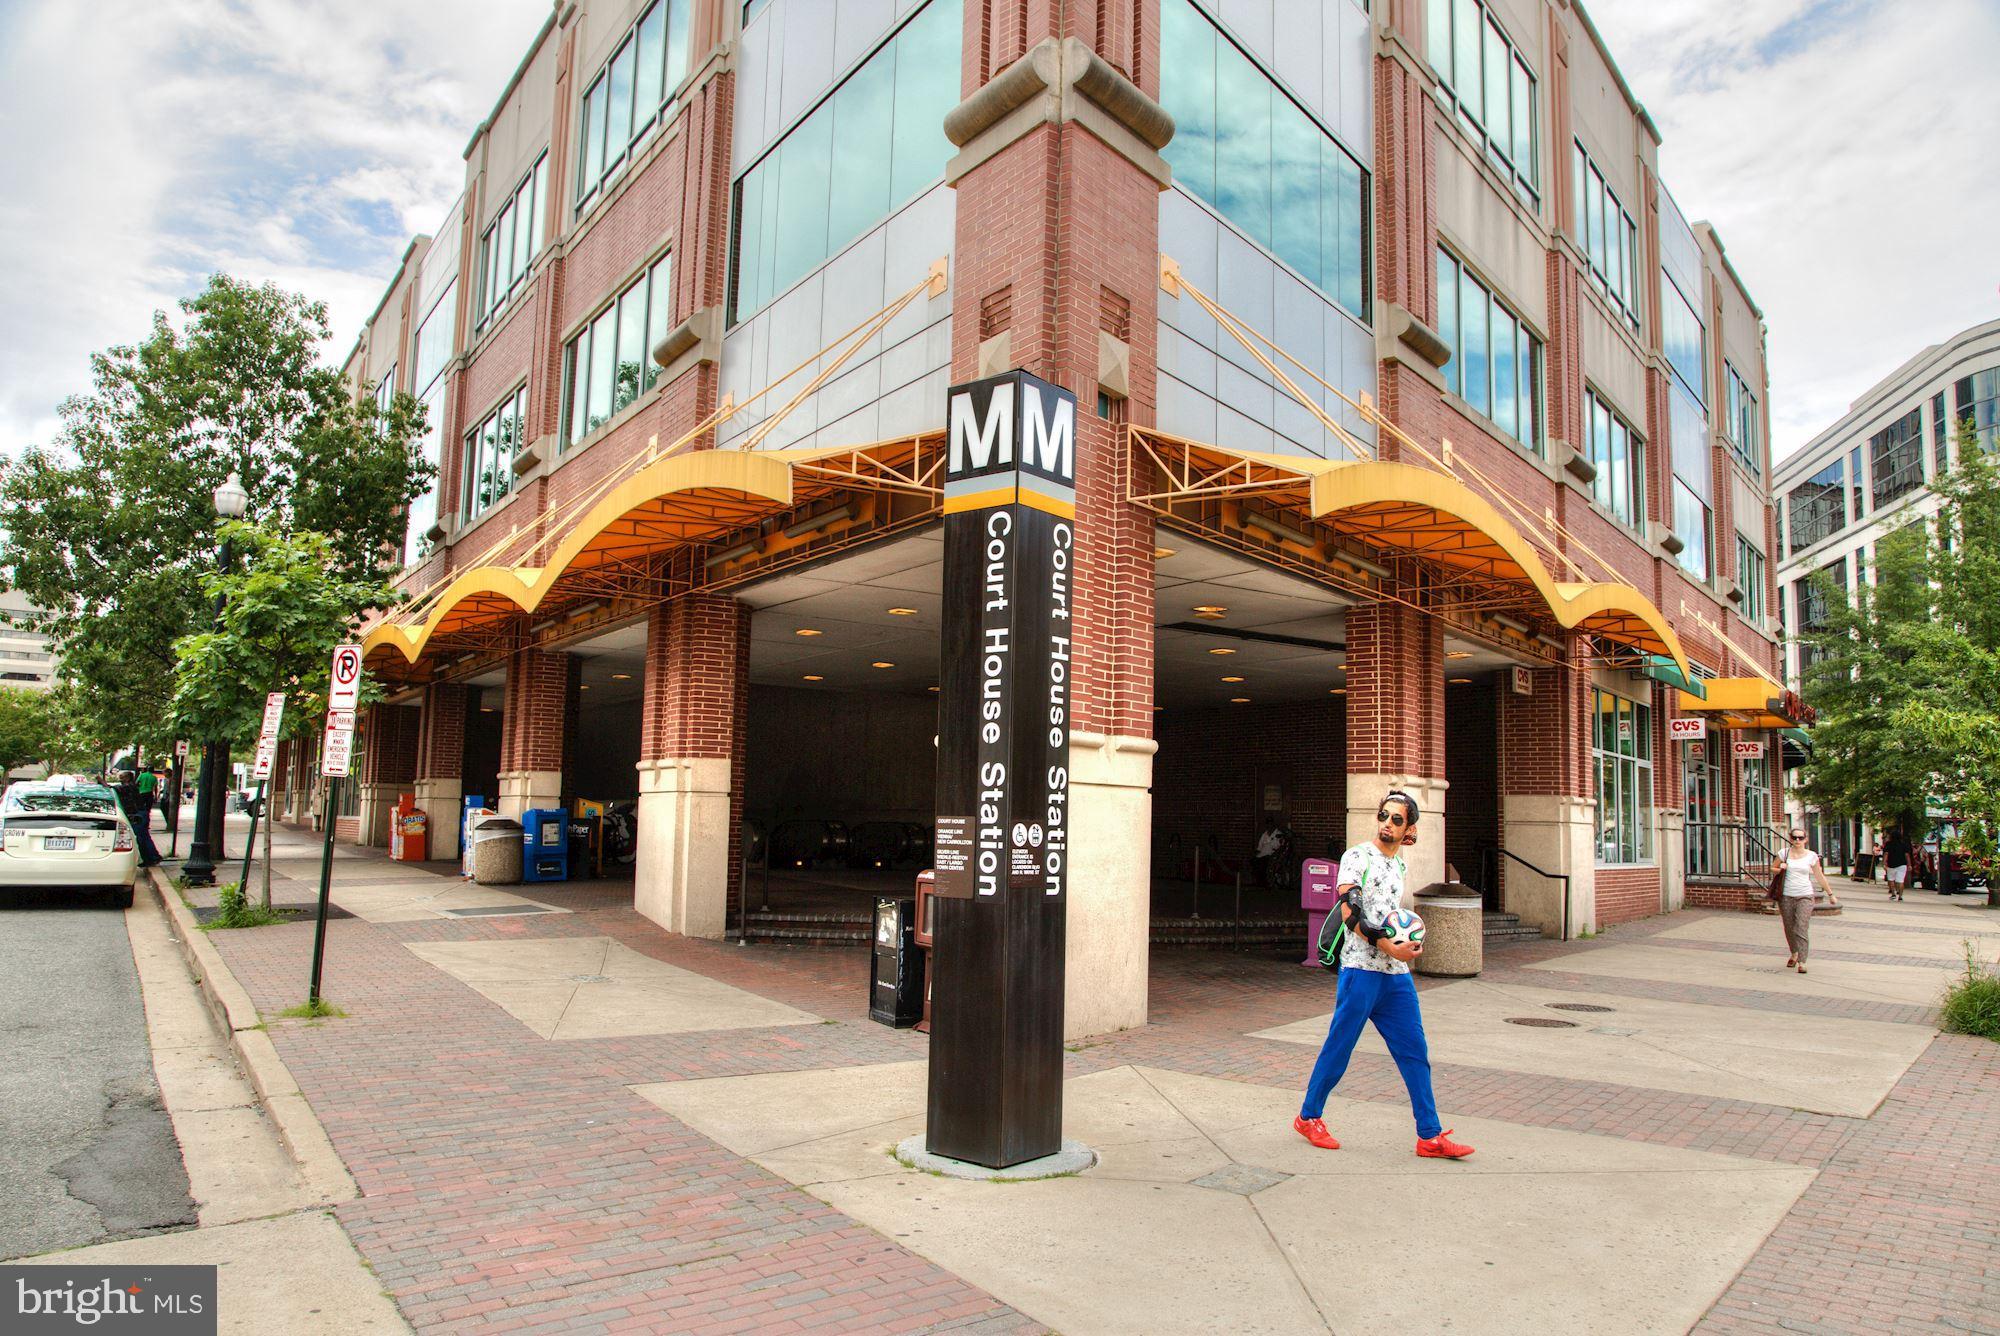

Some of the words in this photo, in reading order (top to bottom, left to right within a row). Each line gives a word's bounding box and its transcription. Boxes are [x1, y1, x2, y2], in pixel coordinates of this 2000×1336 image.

[950, 382, 1014, 474] M
[1022, 383, 1073, 480] M
[986, 511, 1012, 612] Court
[1052, 523, 1072, 620] Court
[982, 627, 1008, 744] House
[1049, 635, 1069, 748] House
[1672, 720, 1700, 732] CVS
[1735, 743, 1759, 752] CVS
[4, 829, 25, 837] CROWN
[978, 761, 1006, 896] Station
[1046, 765, 1067, 896] Station
